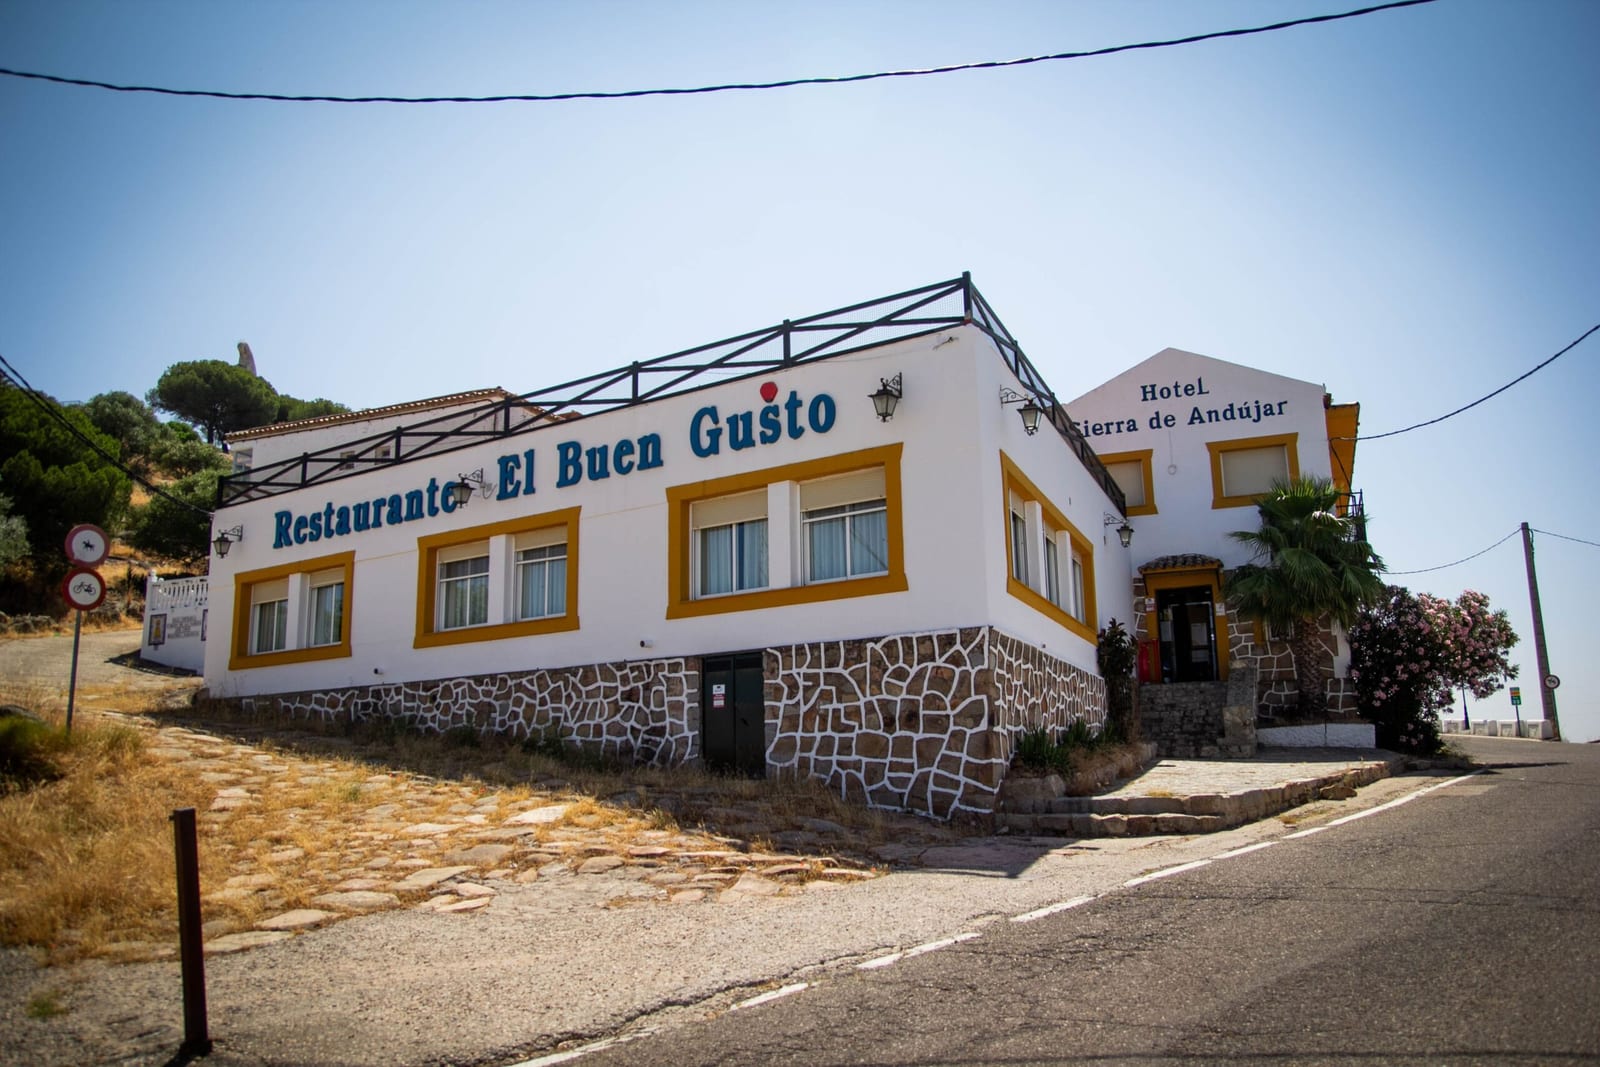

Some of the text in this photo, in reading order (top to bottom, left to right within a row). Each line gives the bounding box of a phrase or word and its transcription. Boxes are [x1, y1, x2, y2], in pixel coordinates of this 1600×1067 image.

[1149, 411, 1176, 430] de
[1187, 400, 1288, 426] Andújar
[273, 390, 837, 549] Restaurante El Buen Gusto
